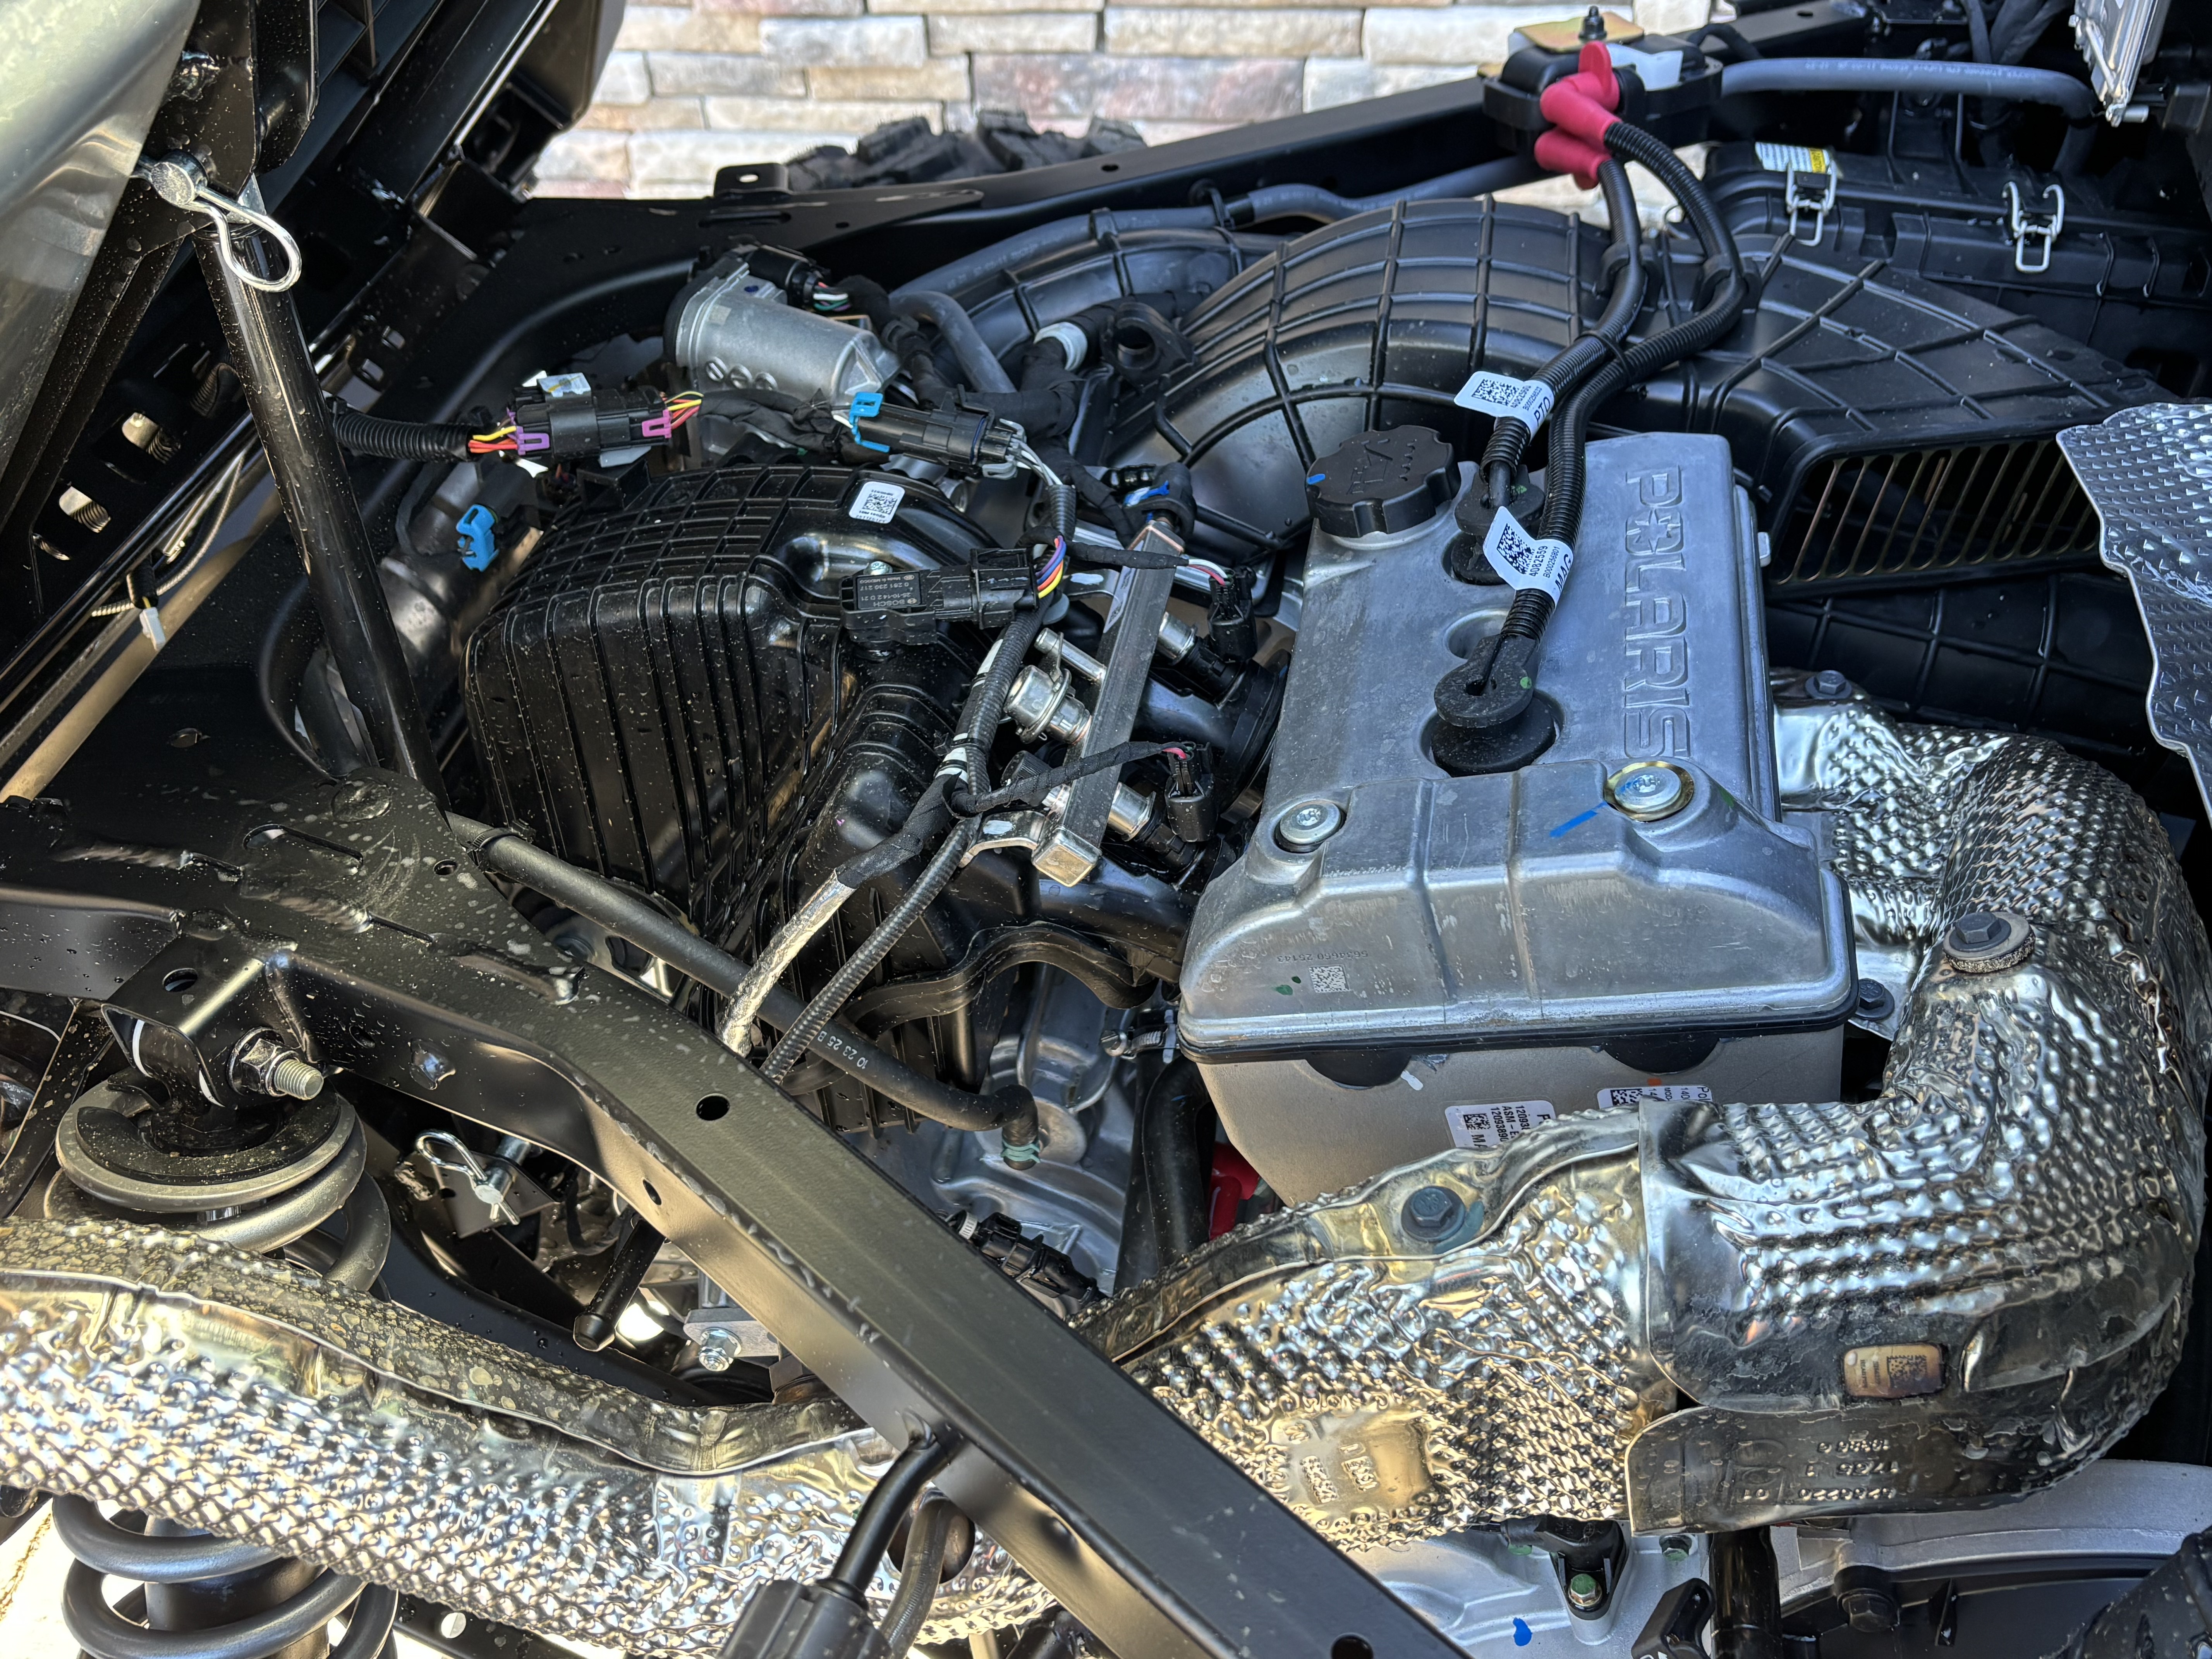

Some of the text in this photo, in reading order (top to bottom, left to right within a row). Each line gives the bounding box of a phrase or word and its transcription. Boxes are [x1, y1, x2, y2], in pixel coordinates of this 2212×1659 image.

[1534, 396, 1551, 427] PTO
[1528, 546, 1548, 577] 4082559
[873, 599, 905, 607] BOSCH
[1624, 465, 1690, 758] POLARIS
[1277, 950, 1369, 963] 5634650 25143
[817, 1030, 869, 1069] 10 23 25 B
[1502, 1106, 1516, 1123] ASM
